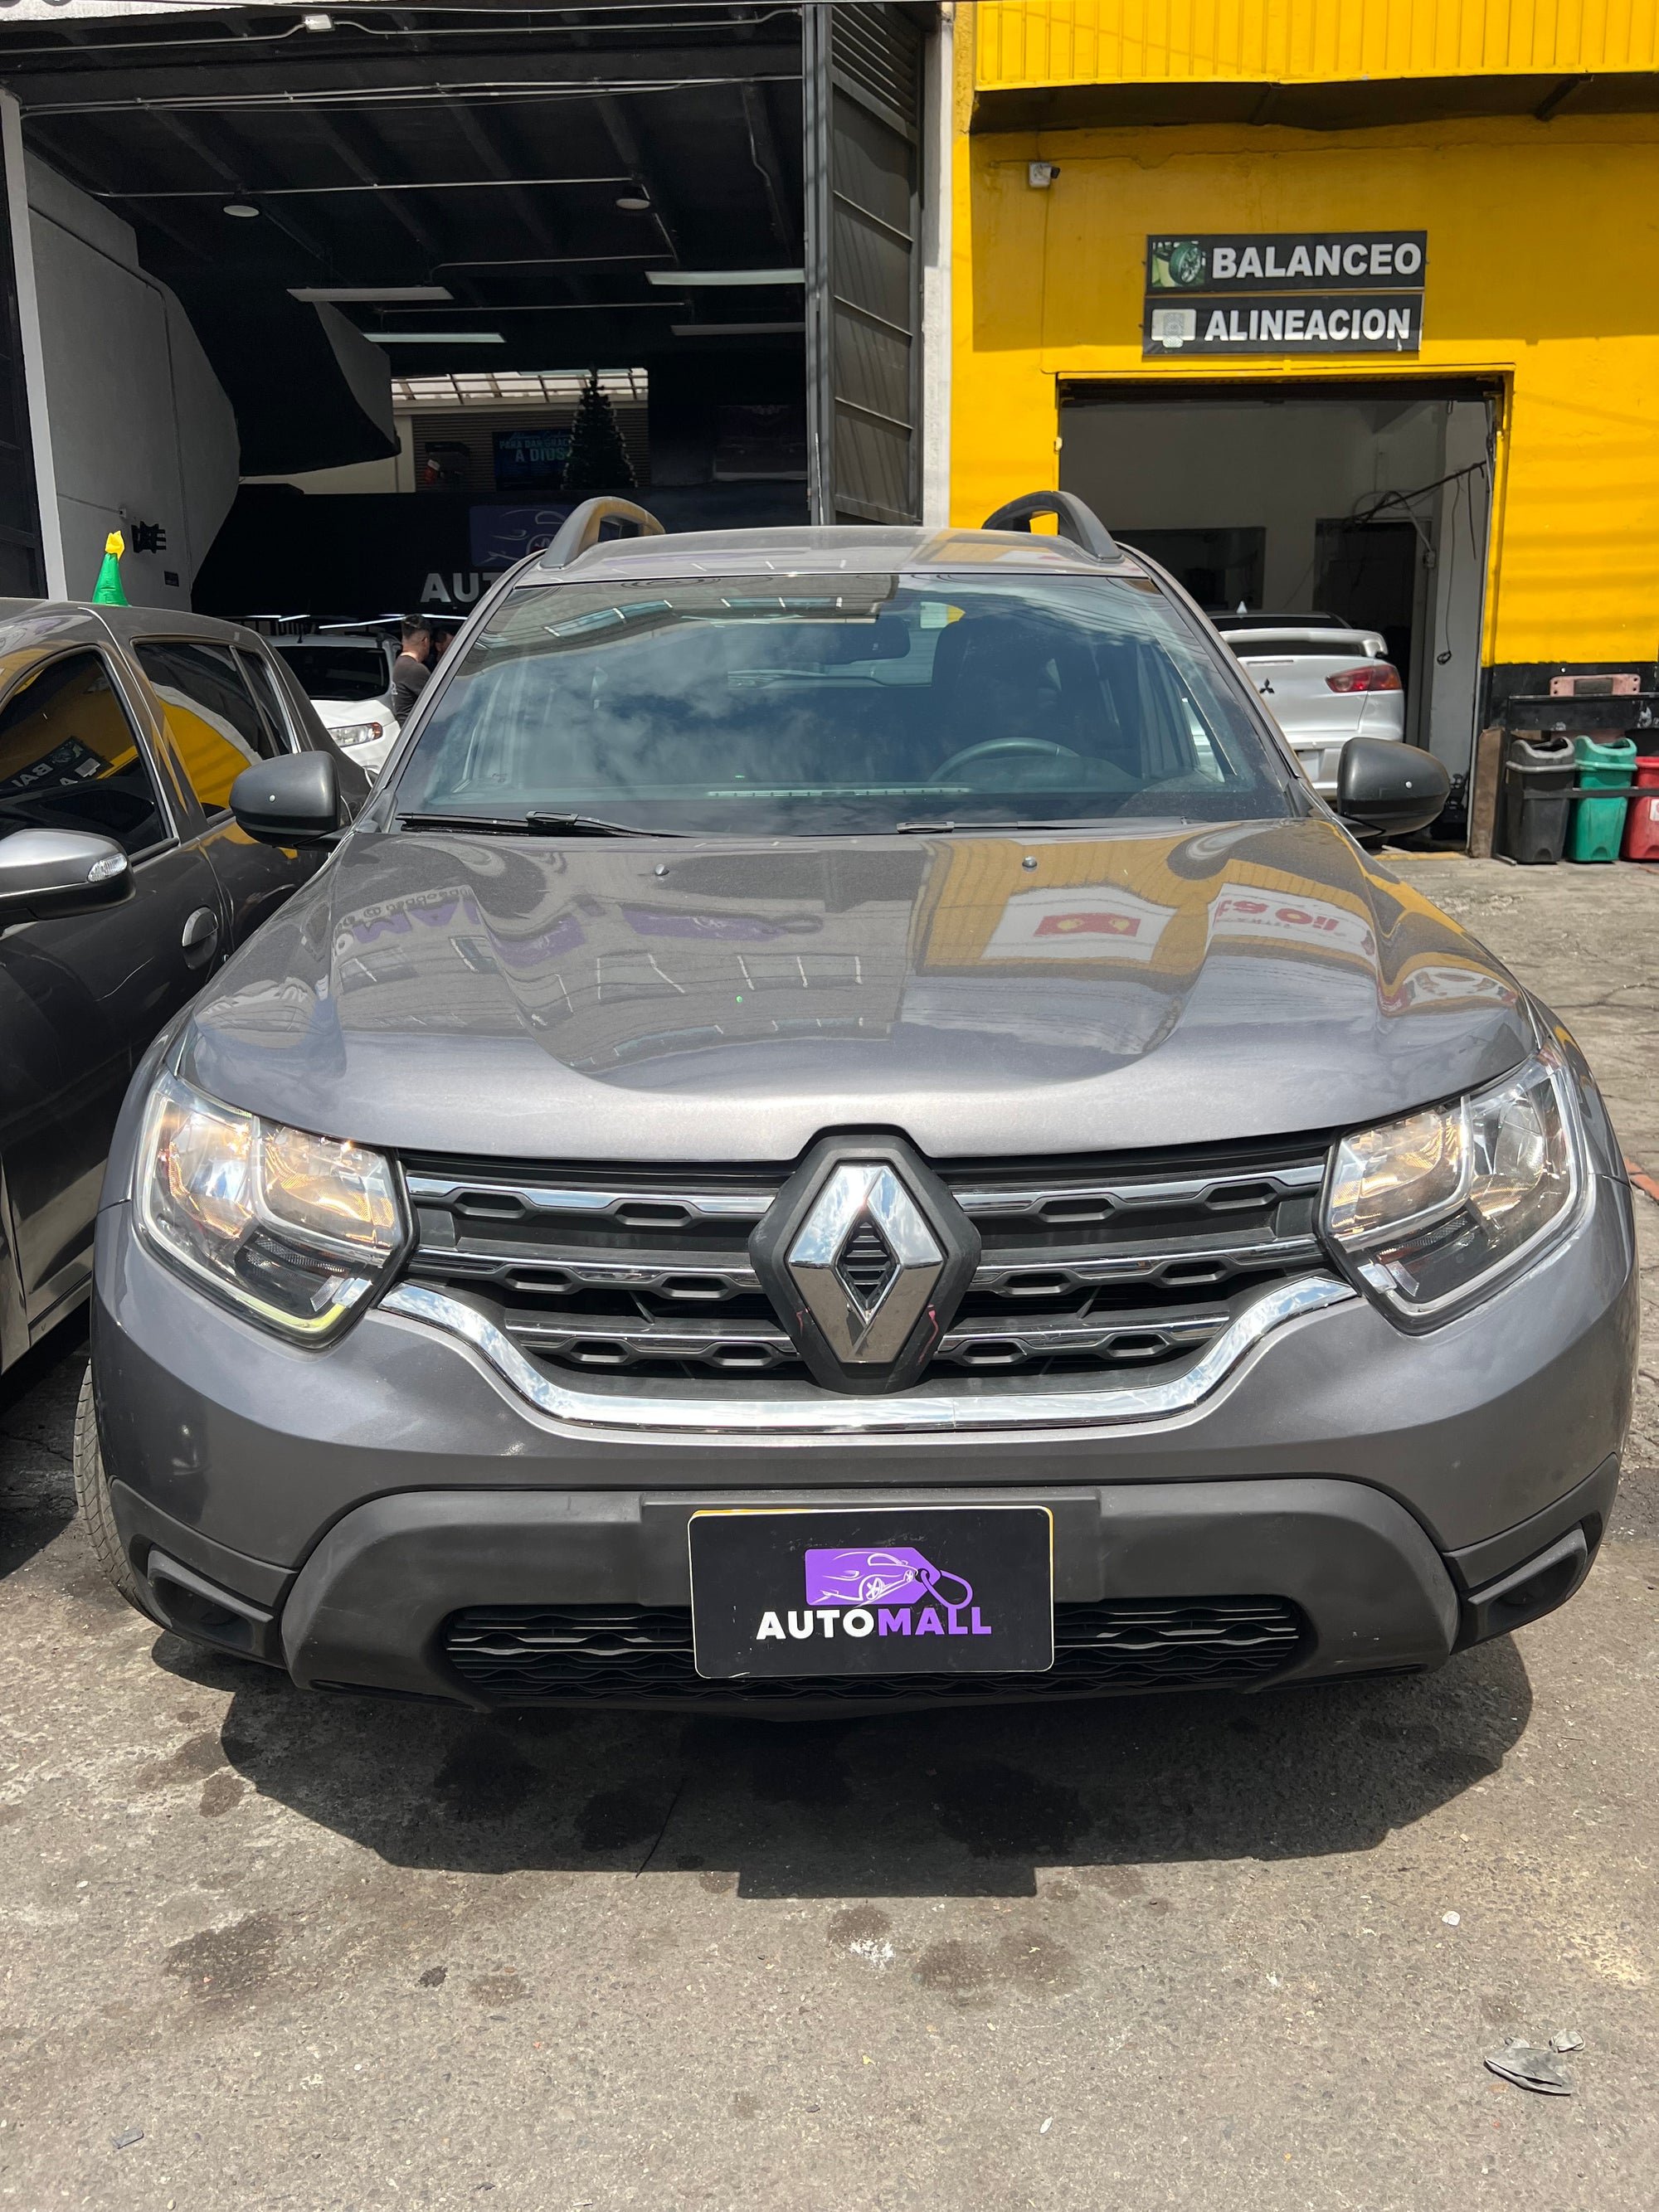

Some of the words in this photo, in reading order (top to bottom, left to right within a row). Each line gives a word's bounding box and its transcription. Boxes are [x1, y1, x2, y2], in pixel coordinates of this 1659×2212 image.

[1211, 242, 1423, 280] BALANCEO
[1203, 307, 1412, 343] ALINEACION
[515, 448, 525, 462] A
[529, 447, 566, 462] DIOS
[756, 1606, 993, 1641] AUTOMALL
